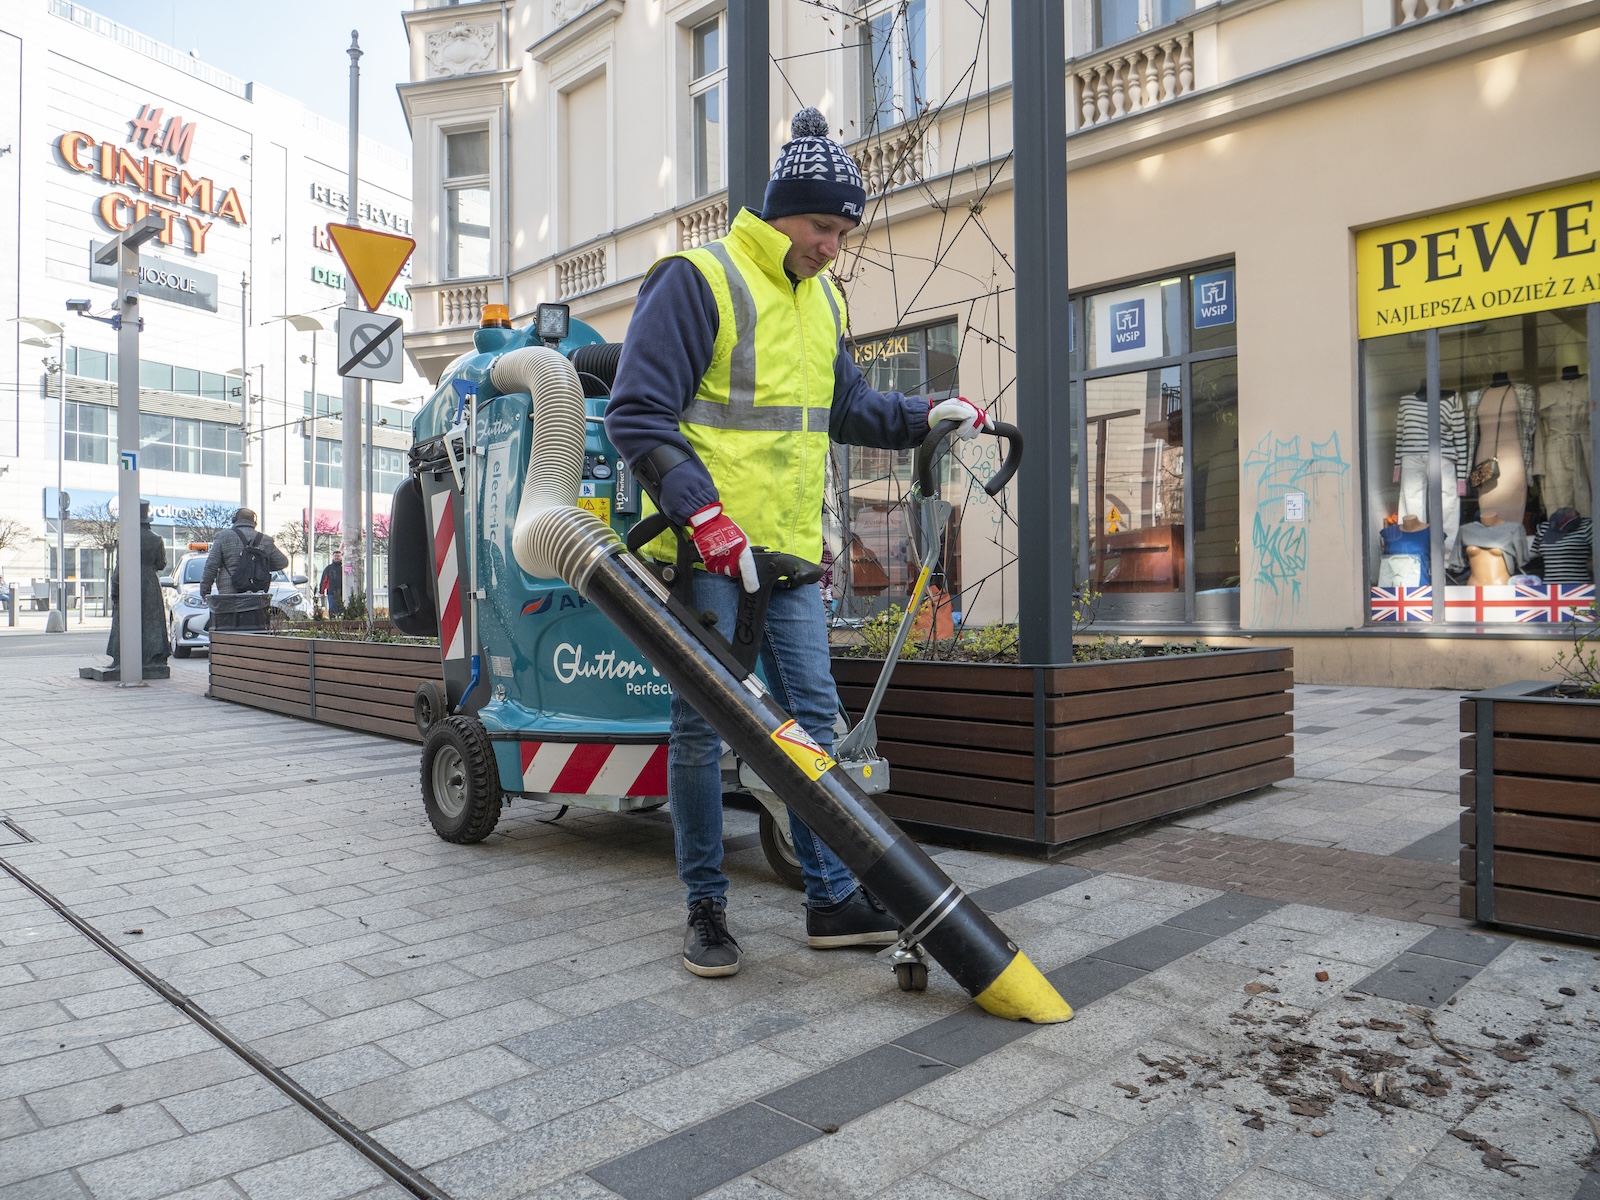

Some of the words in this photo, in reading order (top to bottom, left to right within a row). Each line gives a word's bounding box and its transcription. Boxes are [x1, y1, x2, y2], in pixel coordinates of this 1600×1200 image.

[784, 154, 828, 166] FILA
[788, 143, 826, 155] FILA
[60, 131, 247, 225] CINEMA
[782, 163, 829, 178] FILA
[1376, 200, 1597, 292] PEWE
[1201, 304, 1228, 318] WSiP
[1376, 295, 1476, 326] NAJLEPSZA
[1481, 277, 1557, 308] ODZIEŻ
[1562, 278, 1576, 296] Z
[1116, 331, 1140, 343] WSiP
[489, 460, 502, 541] electric
[553, 642, 647, 684] Glutton
